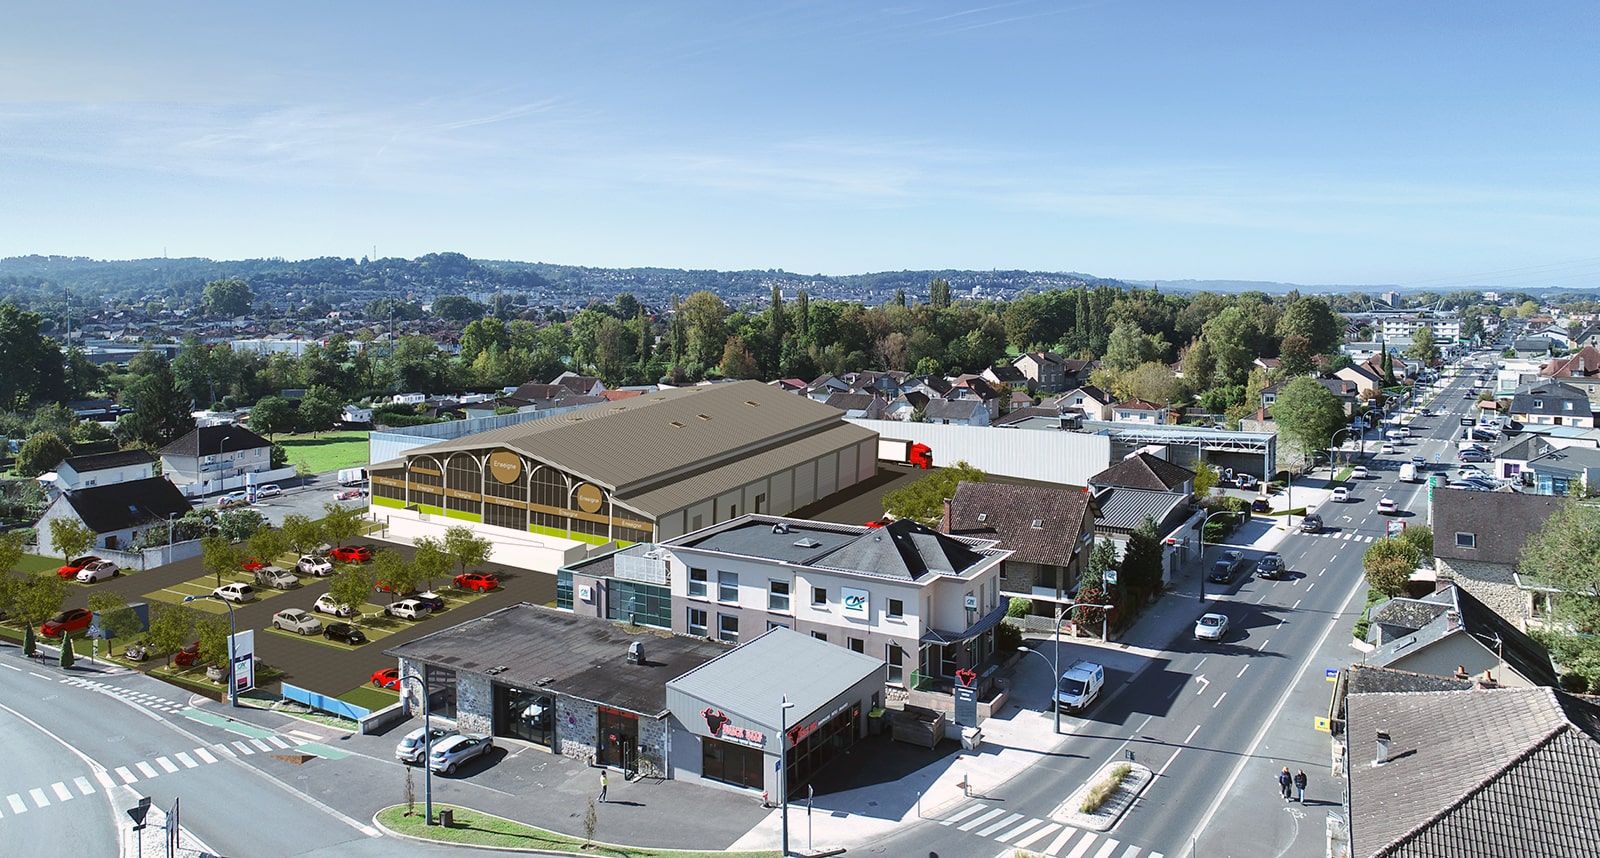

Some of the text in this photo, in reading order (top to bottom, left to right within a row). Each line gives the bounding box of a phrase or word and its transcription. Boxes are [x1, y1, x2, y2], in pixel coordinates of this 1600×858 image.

[493, 460, 517, 470] Enseigne
[379, 478, 397, 486] Enseigne
[416, 485, 435, 493] Enseigne
[453, 491, 472, 499] Enseigne
[495, 498, 514, 506] Enseigne
[579, 495, 599, 504] Enseigne
[559, 509, 578, 518] Enseigne
[622, 520, 642, 529] Enseigne
